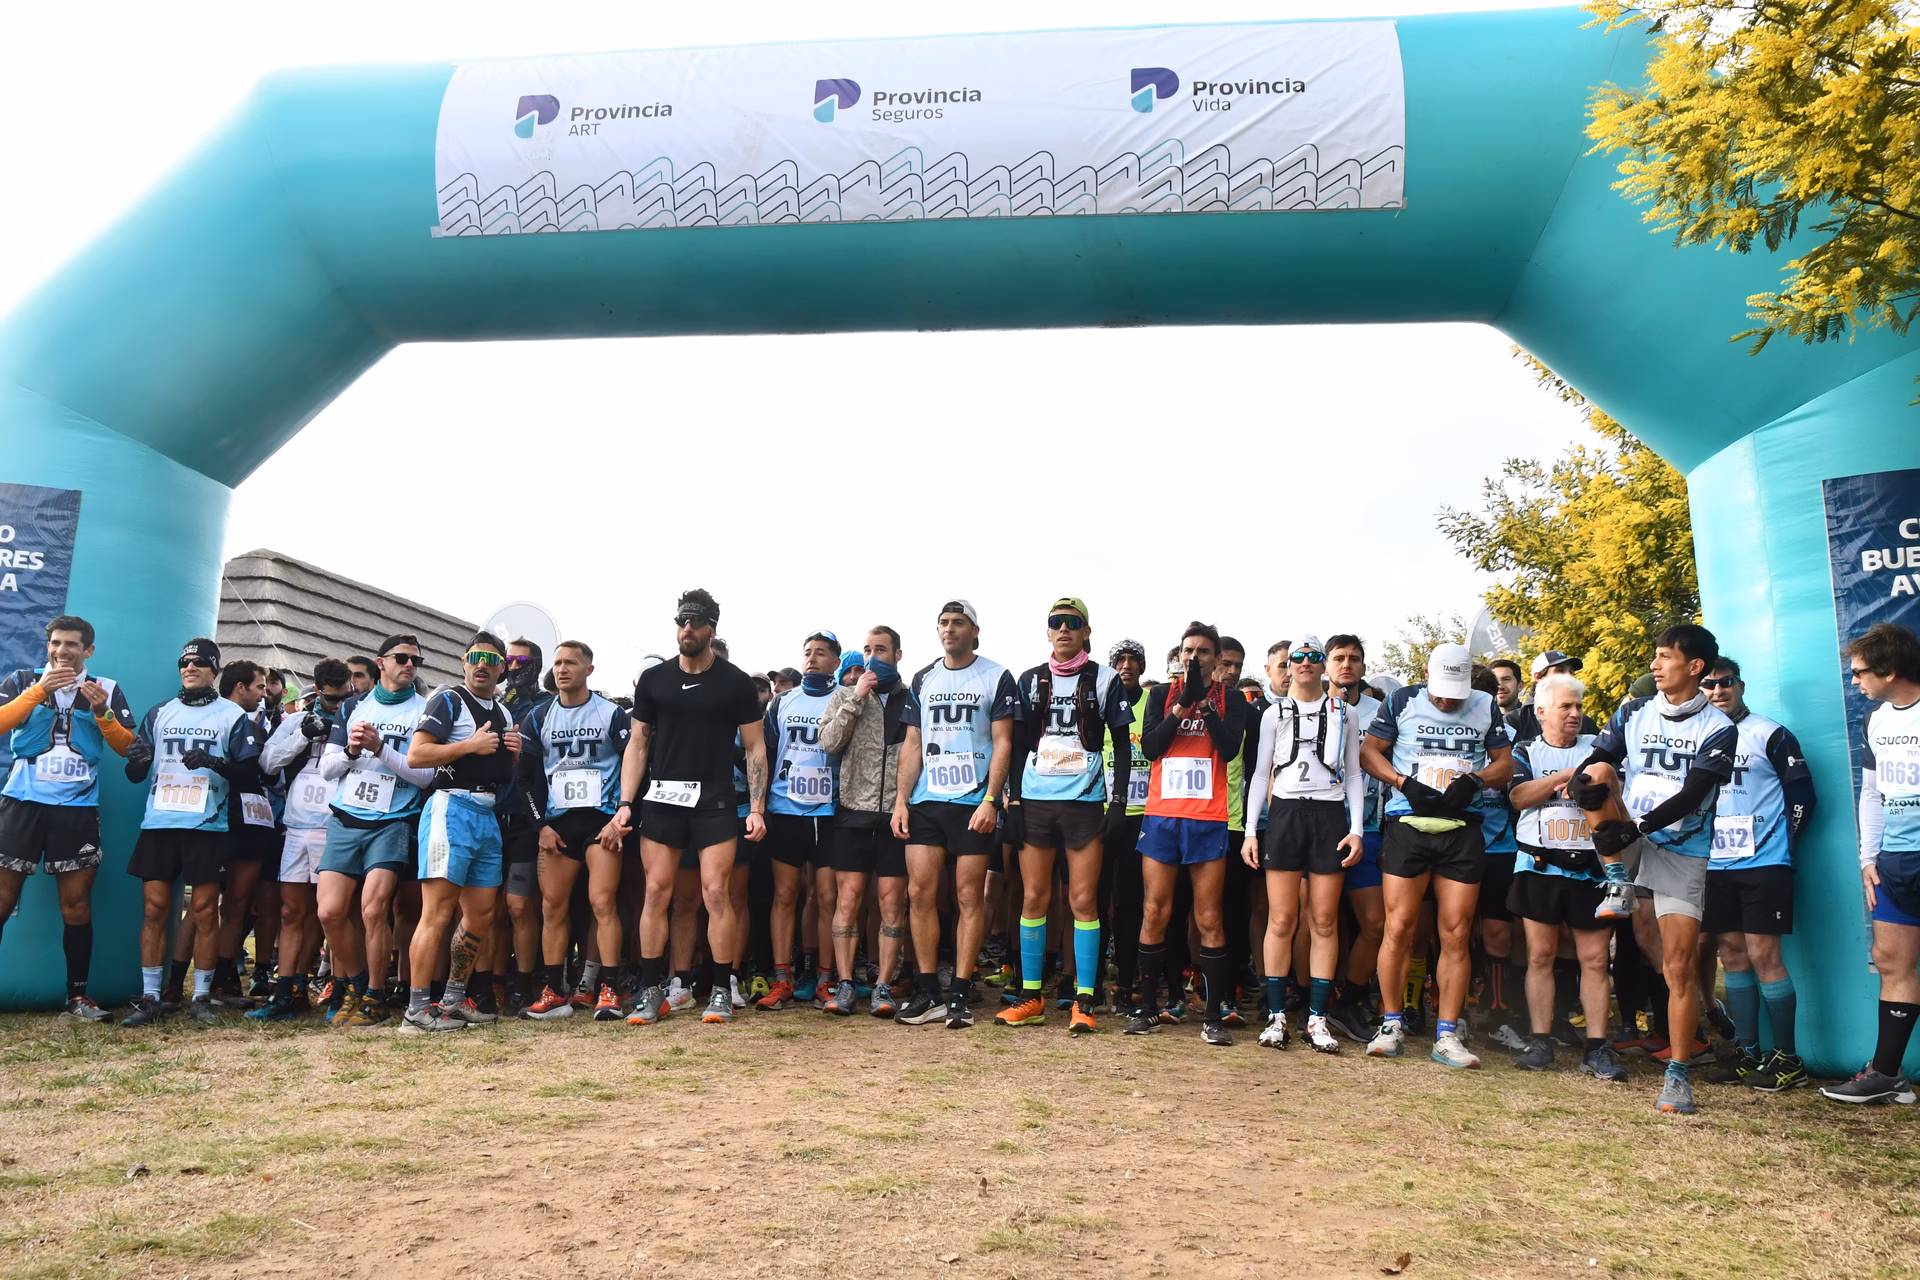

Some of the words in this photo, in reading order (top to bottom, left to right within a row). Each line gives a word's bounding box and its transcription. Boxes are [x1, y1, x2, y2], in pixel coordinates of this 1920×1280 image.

[873, 87, 982, 106] Provincia
[1193, 78, 1306, 96] Provincia
[570, 102, 673, 122] Provincia
[1192, 98, 1231, 112] Vida
[872, 108, 944, 123] Seguros
[568, 123, 601, 137] ART
[1899, 517, 1920, 540] C
[929, 692, 981, 704] saucony
[787, 715, 822, 725] sauco
[929, 704, 980, 724] TUT
[163, 727, 219, 739] saucony
[371, 722, 411, 736] ucony
[551, 727, 602, 740] saucony
[787, 727, 819, 745] TU
[1417, 724, 1480, 738] saucony
[551, 739, 603, 759] TUT
[1041, 749, 1084, 769] 1165
[39, 756, 87, 777] 1565
[929, 764, 974, 787] 1600
[1297, 761, 1310, 782] 2
[1878, 760, 1920, 786] 1663
[380, 774, 395, 782] TUT
[789, 776, 831, 796] 1606
[1168, 769, 1206, 790] 1710
[1424, 767, 1466, 789] 116
[162, 783, 203, 806] 1118
[303, 784, 327, 805] 98
[354, 781, 380, 803] 45
[564, 780, 588, 801] 63
[653, 790, 692, 803] 520
[1889, 808, 1905, 816] ART
[1545, 819, 1591, 841] 1074
